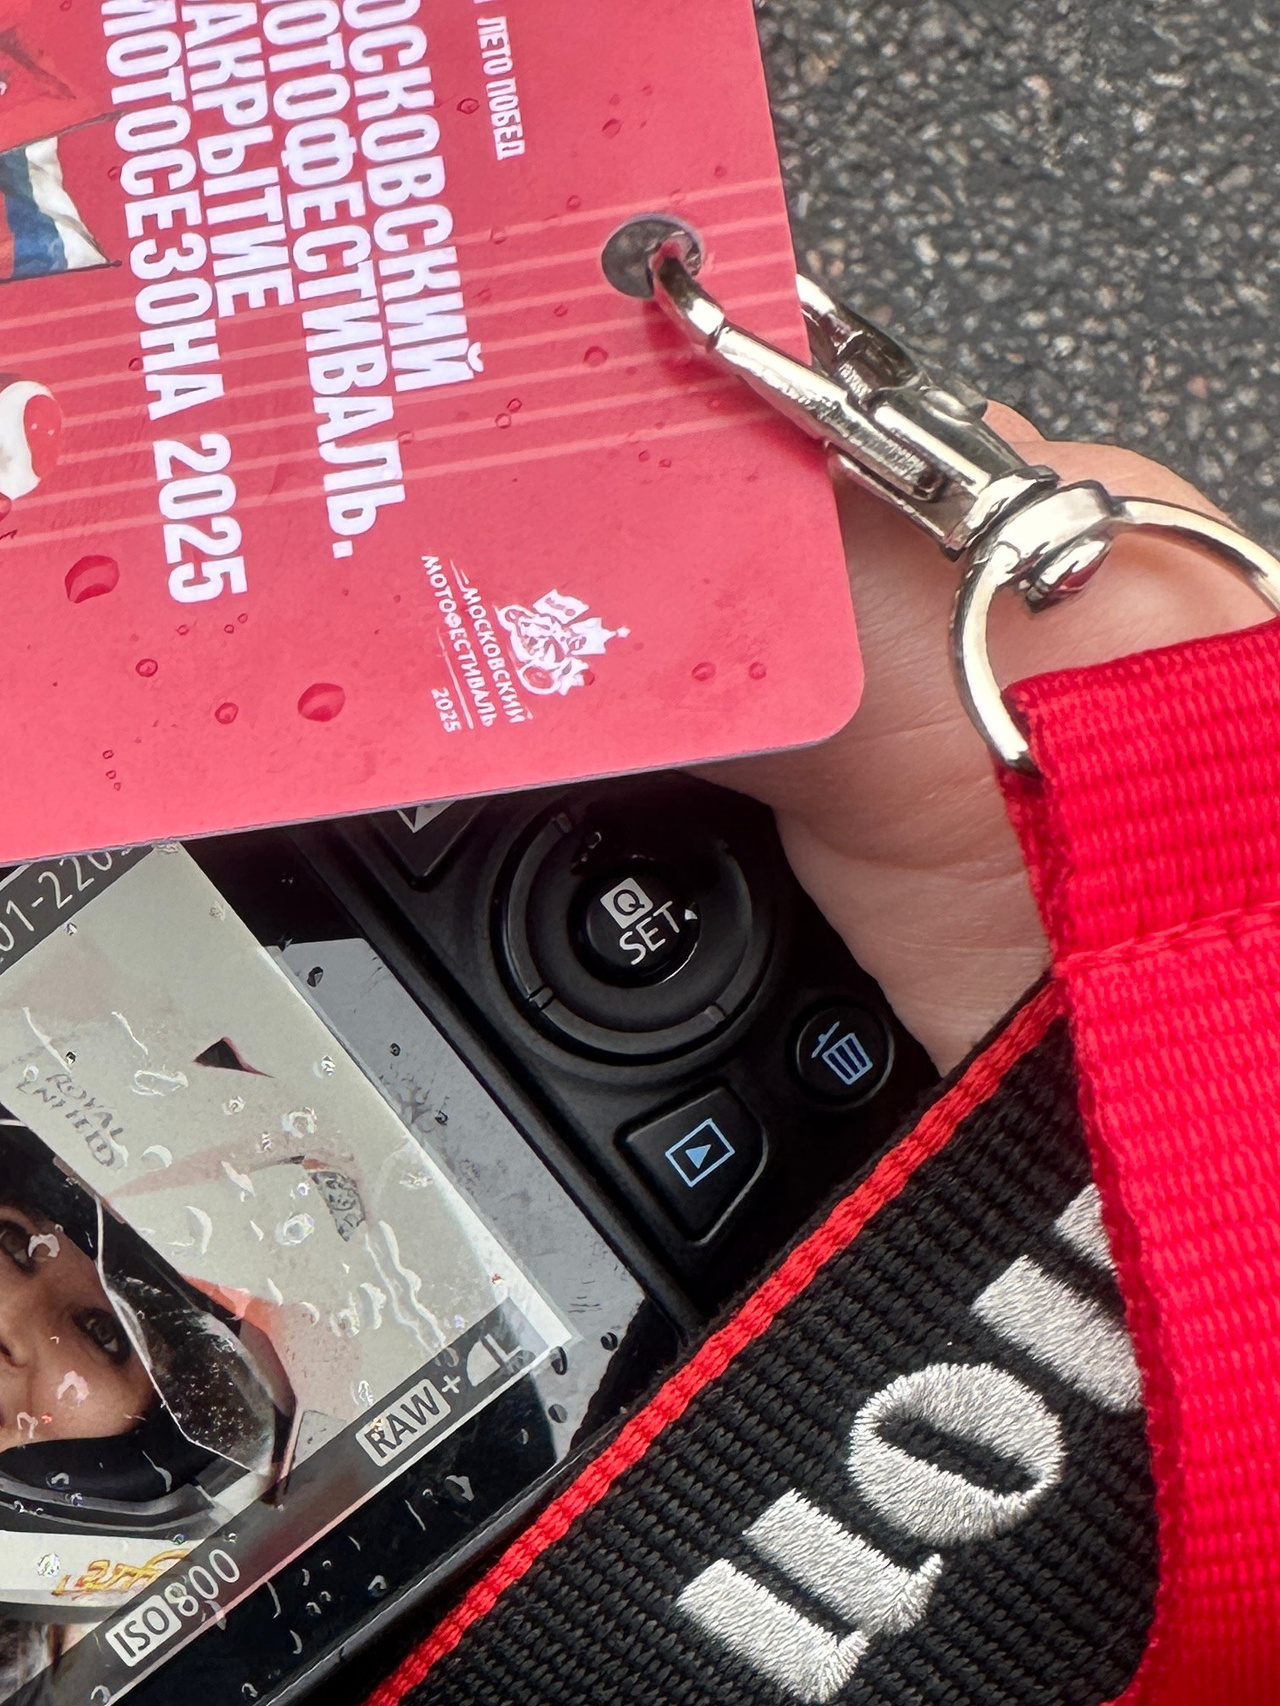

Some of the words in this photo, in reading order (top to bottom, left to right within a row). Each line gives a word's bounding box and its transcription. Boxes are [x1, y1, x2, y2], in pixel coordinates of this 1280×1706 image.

[477, 16, 513, 76] ЛЕТО
[181, 0, 295, 318] АКРЫТИЕ
[342, 0, 483, 392] ОСКОВСКИЙ
[261, 0, 406, 559] ОТОФЕСТИВАЛЬ.
[152, 432, 248, 603] 2025
[430, 686, 463, 733] 2025
[620, 902, 680, 965] SET
